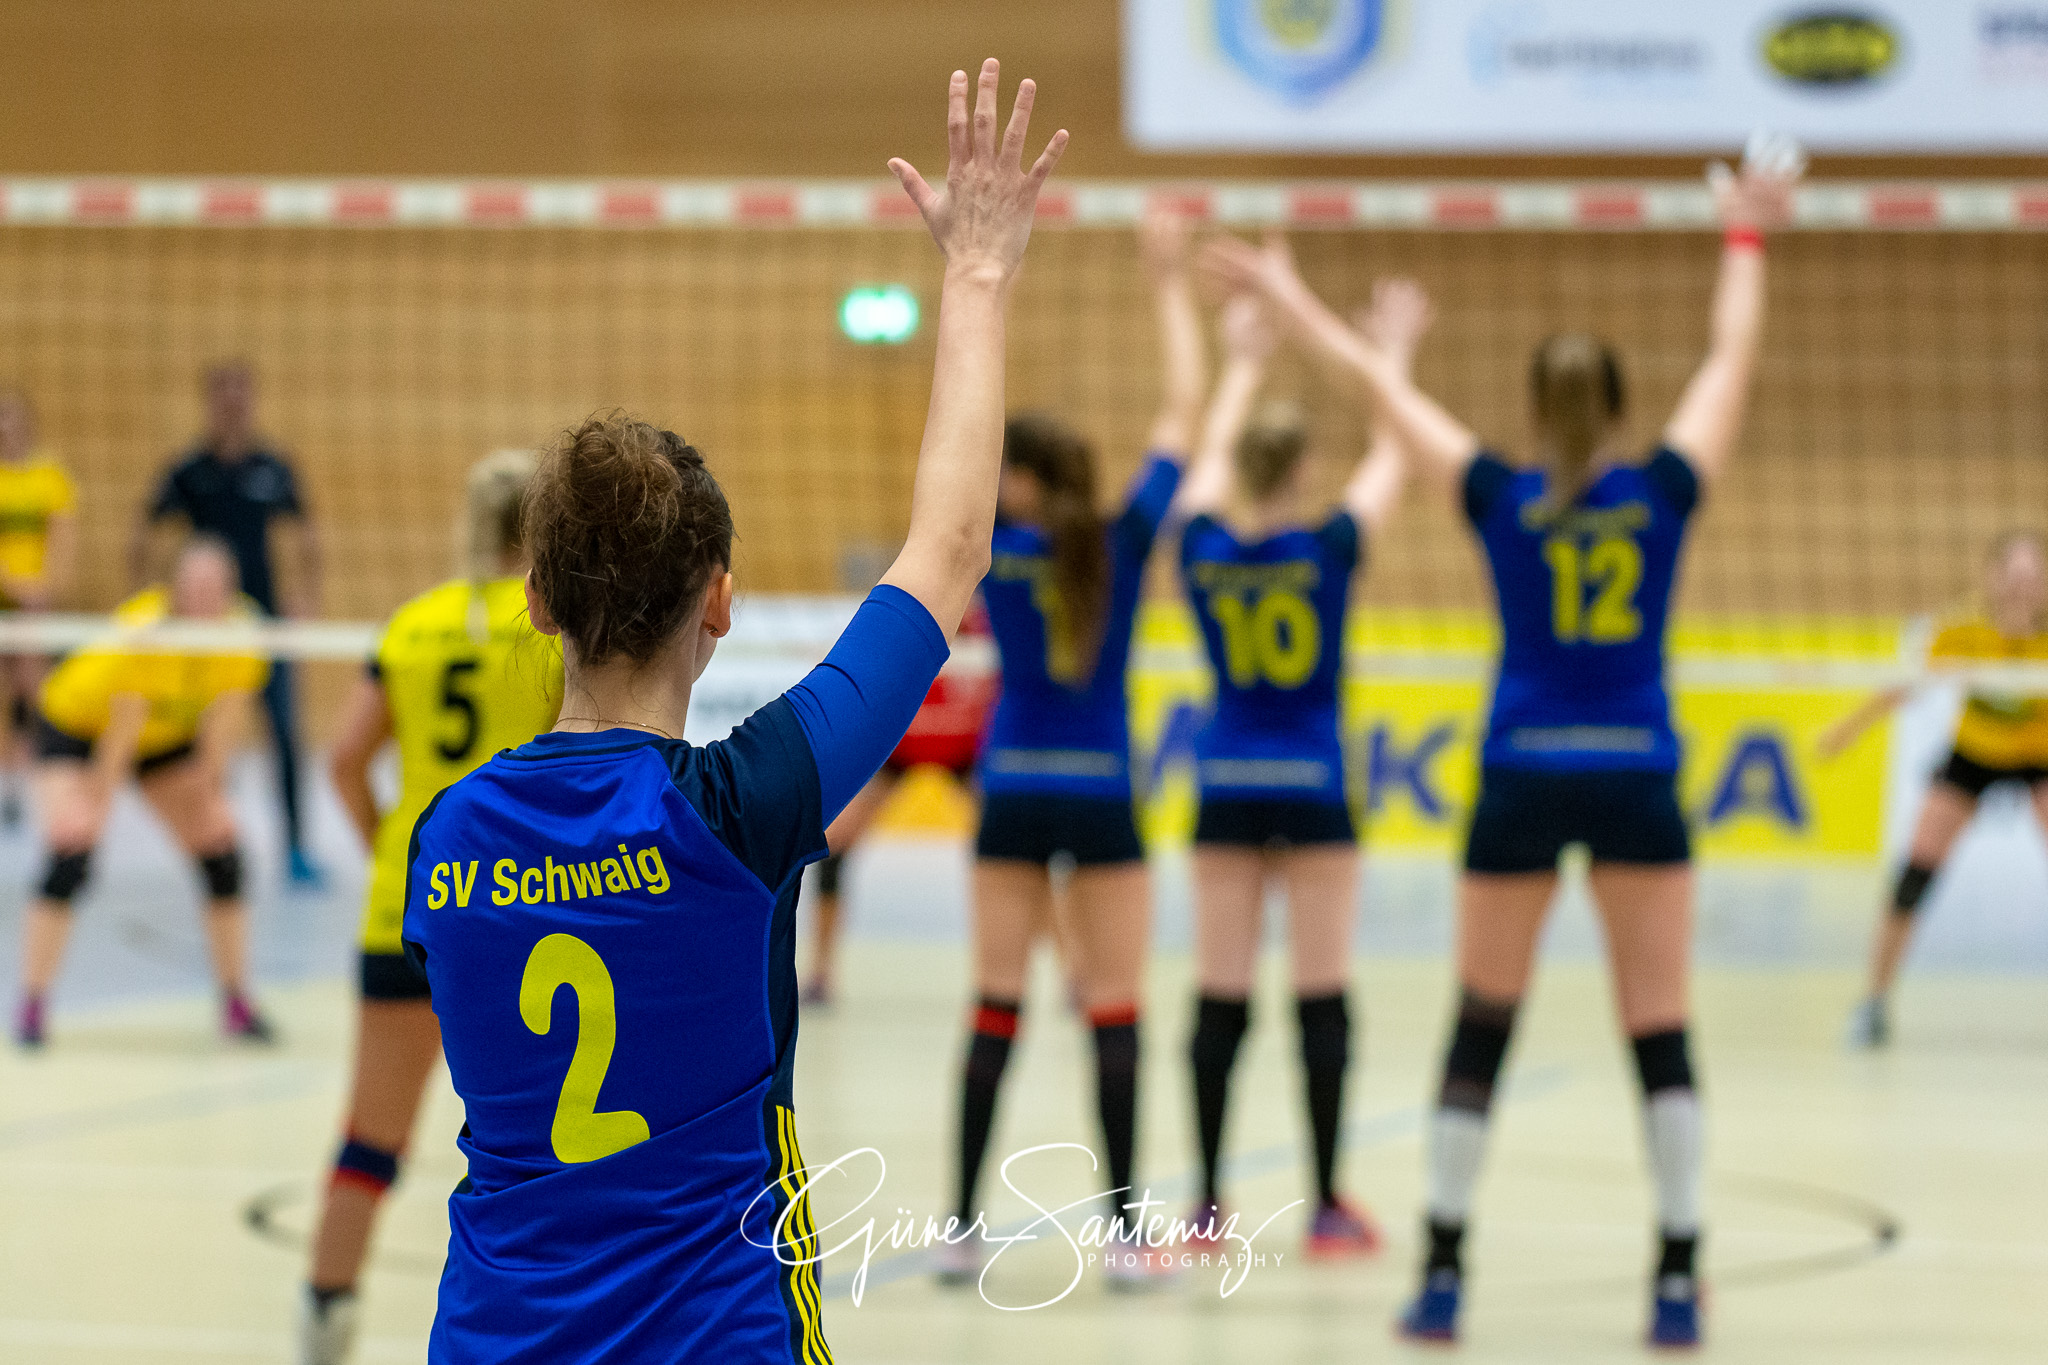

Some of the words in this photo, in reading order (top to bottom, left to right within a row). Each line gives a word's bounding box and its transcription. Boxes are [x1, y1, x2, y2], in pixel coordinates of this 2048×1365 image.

[1212, 594, 1321, 686] 10
[1544, 539, 1643, 640] 12
[437, 660, 483, 764] 5
[427, 860, 479, 911] SV
[491, 843, 671, 906] Schwaig
[519, 933, 651, 1164] 2
